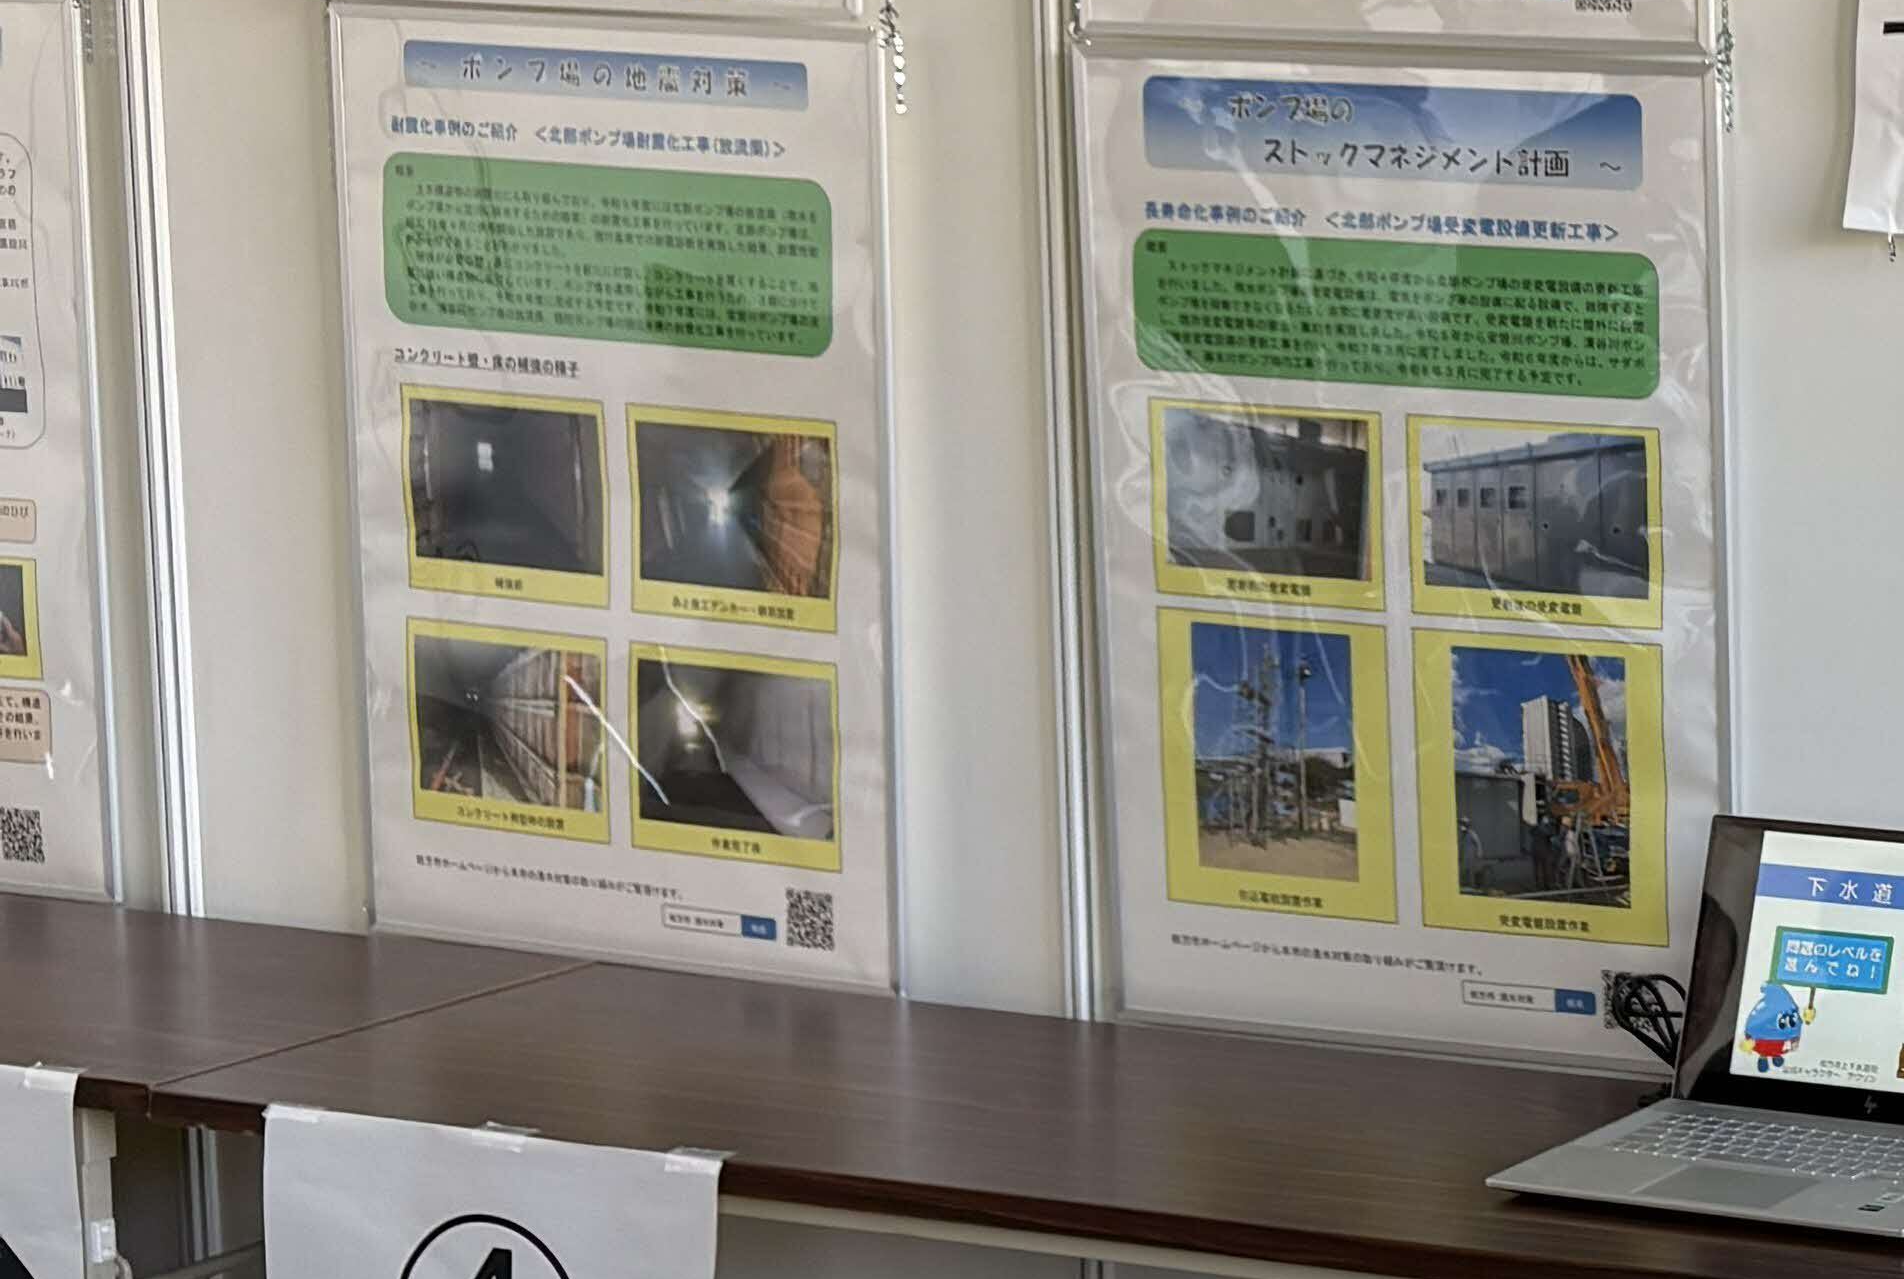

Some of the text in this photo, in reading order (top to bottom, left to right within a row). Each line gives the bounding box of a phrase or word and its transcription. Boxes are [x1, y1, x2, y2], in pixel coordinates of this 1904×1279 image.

[1264, 138, 1570, 179] ストックマネジメント計画
[1786, 939, 1882, 962] 問題のレベルを
